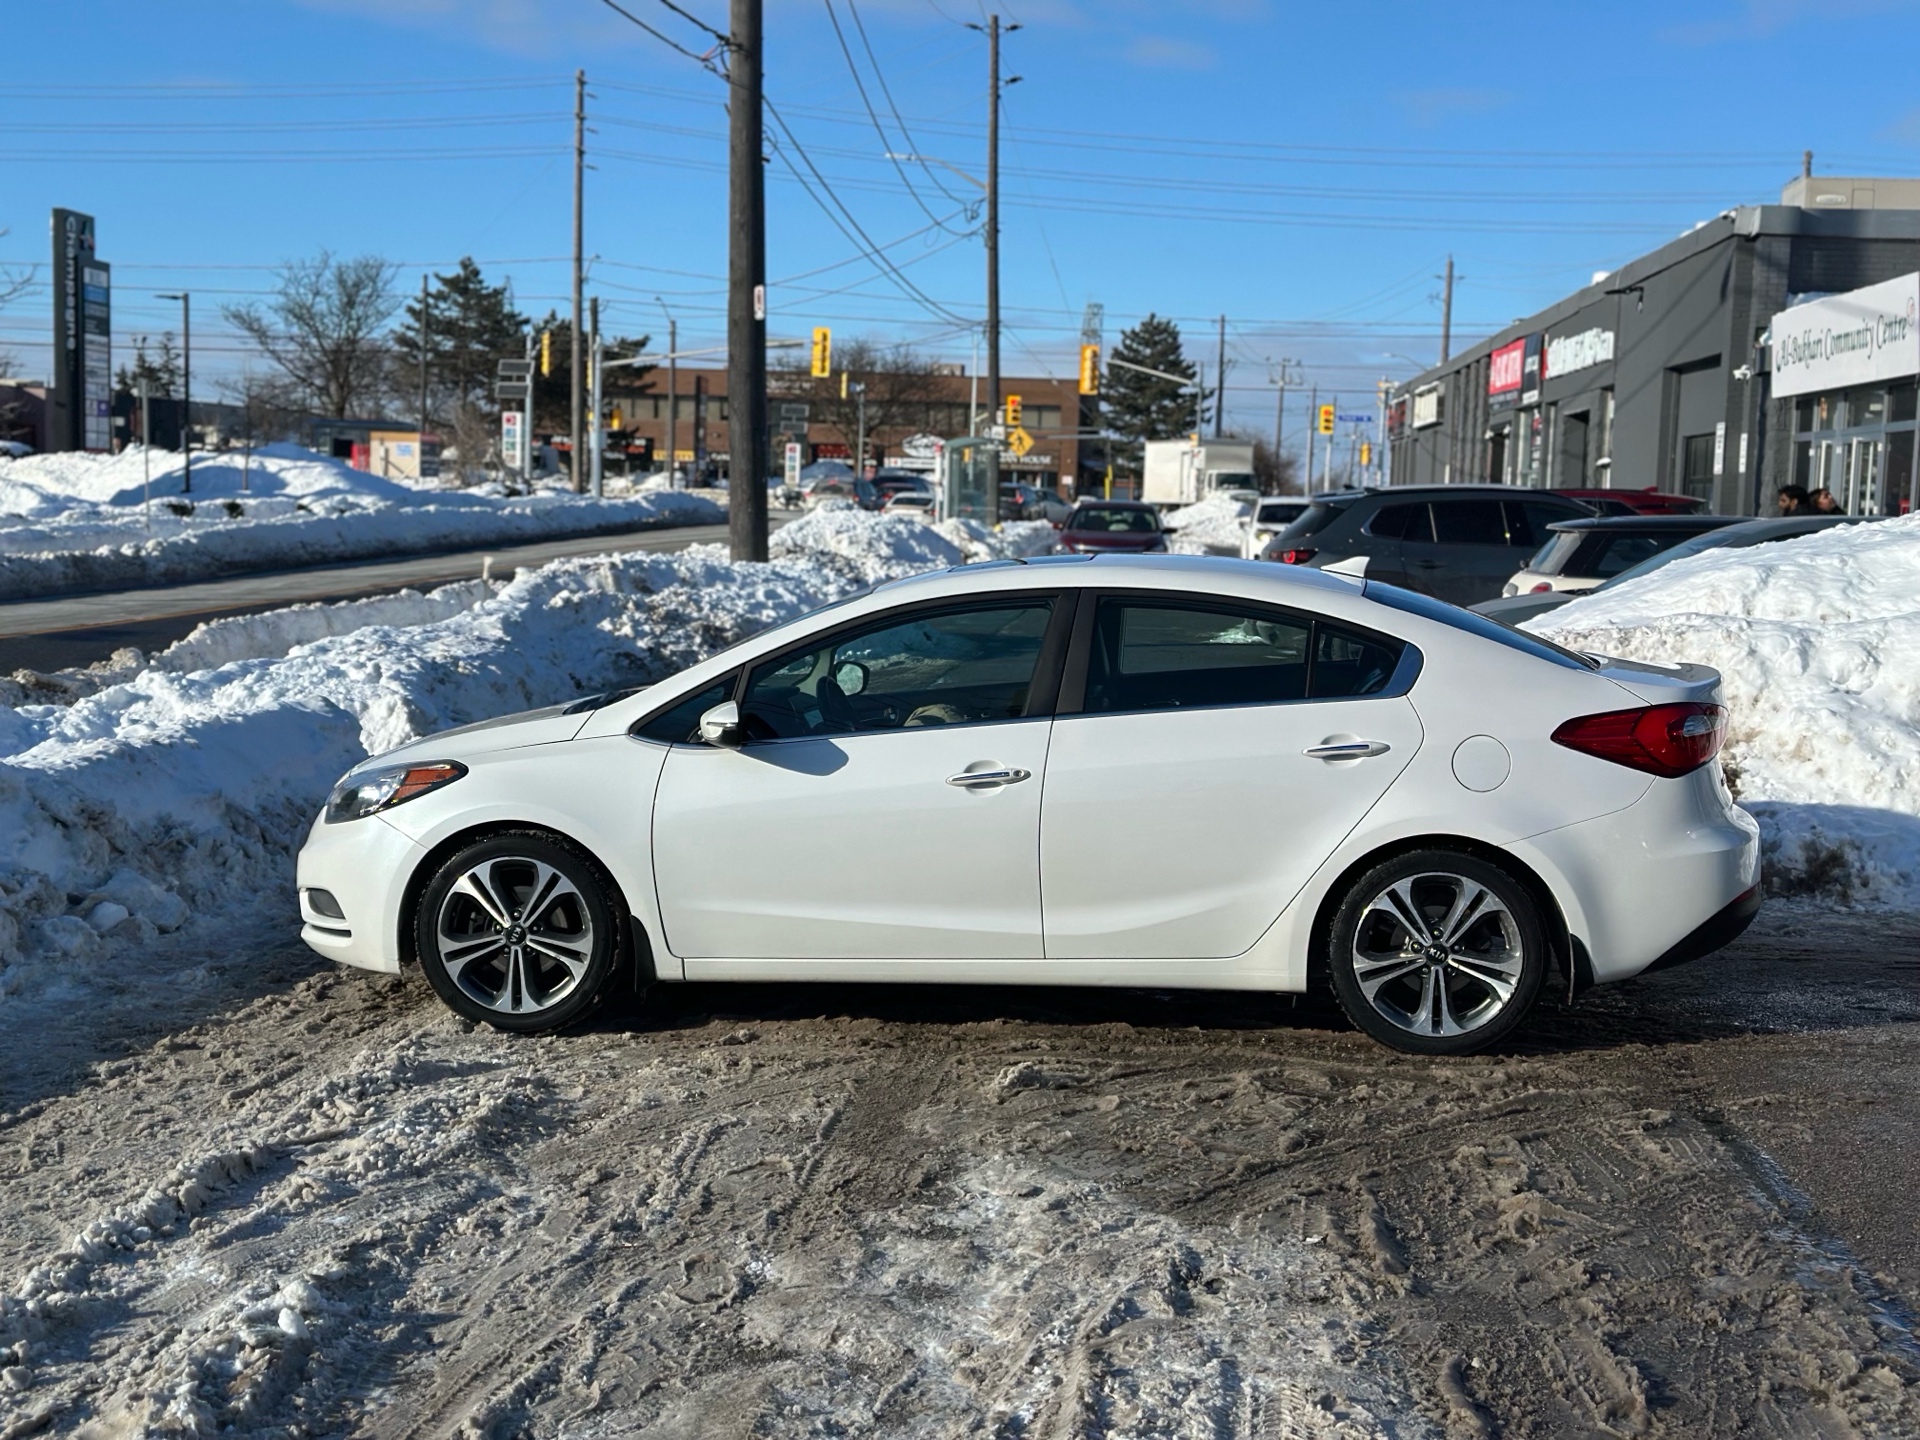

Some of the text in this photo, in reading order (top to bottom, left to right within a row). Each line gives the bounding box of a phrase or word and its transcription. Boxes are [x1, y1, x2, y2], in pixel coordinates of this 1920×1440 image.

[65, 215, 77, 350] Champagne
[1825, 317, 1875, 360] Community
[1876, 314, 1907, 349] Centre
[510, 927, 522, 942] KIA
[1429, 947, 1445, 961] KIA
